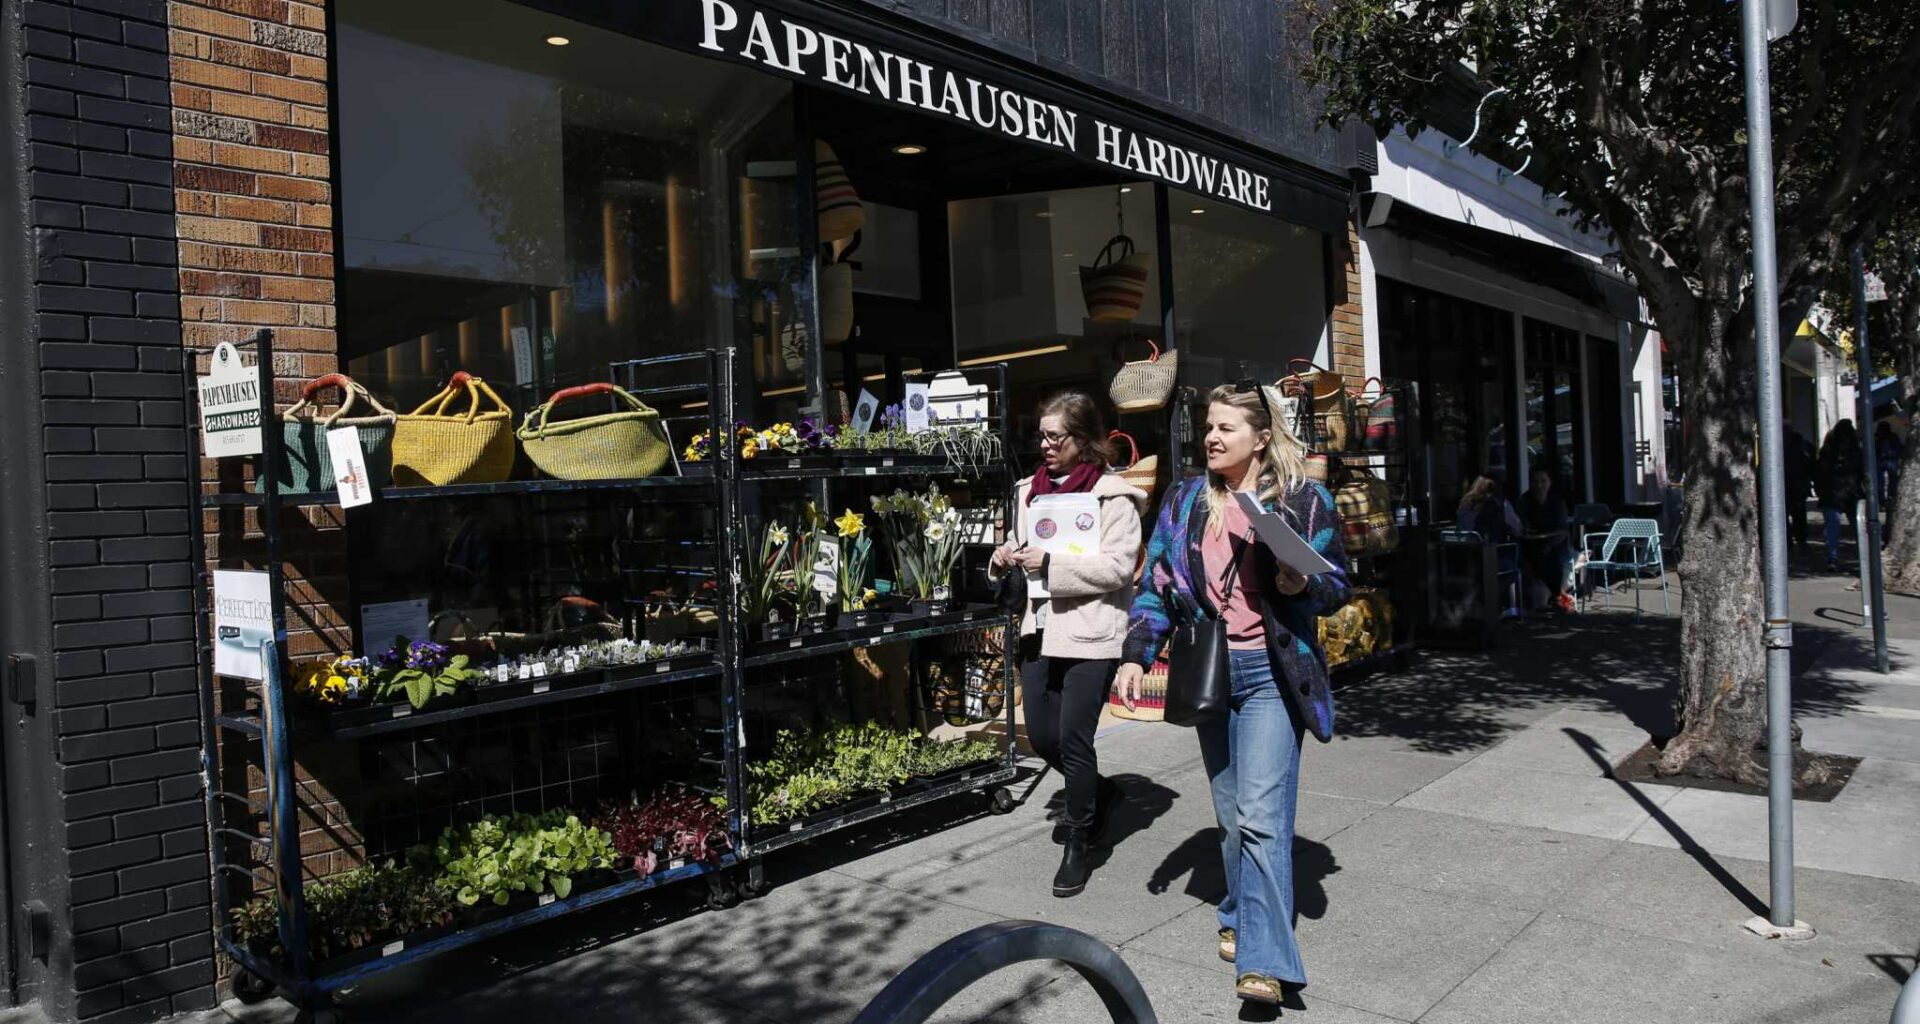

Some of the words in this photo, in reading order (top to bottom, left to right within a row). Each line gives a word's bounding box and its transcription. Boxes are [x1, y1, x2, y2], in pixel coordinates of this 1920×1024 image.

[699, 0, 1077, 152] PAPENHAUSEN
[1096, 120, 1272, 211] HARDWARE
[202, 380, 257, 407] PAPENHAUSEN
[211, 412, 254, 429] HARDWARE
